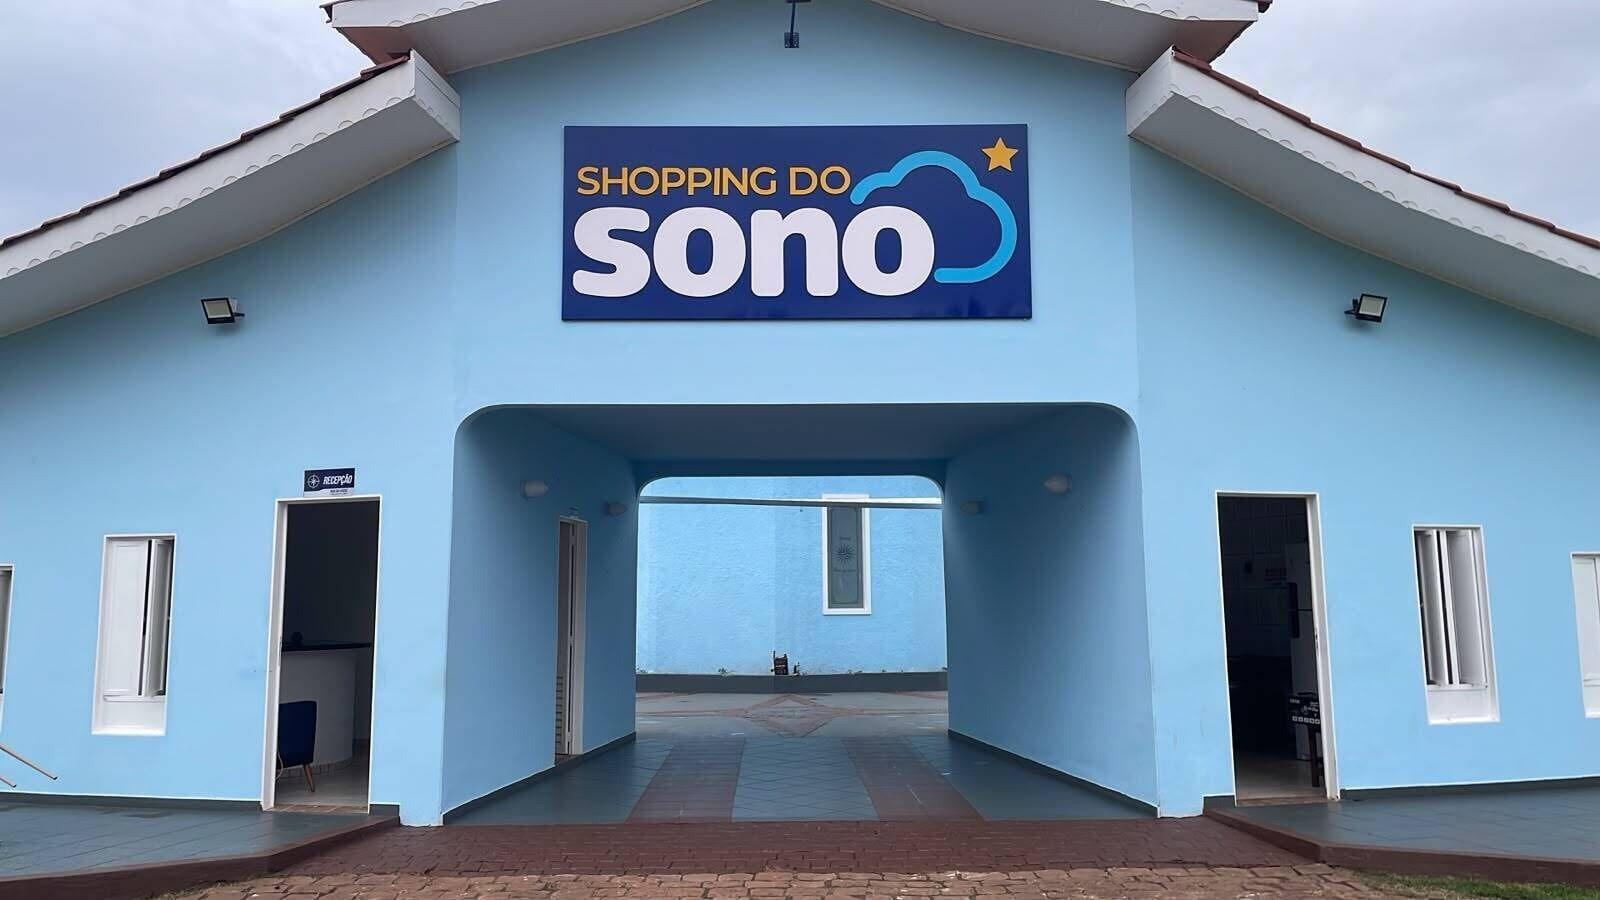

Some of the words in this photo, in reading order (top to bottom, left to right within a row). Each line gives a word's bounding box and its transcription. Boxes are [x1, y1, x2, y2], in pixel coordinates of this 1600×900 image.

[576, 166, 777, 196] SHOPPING
[789, 166, 851, 196] DO
[572, 205, 935, 298] sono
[322, 474, 353, 485] RECEPÇÃO
